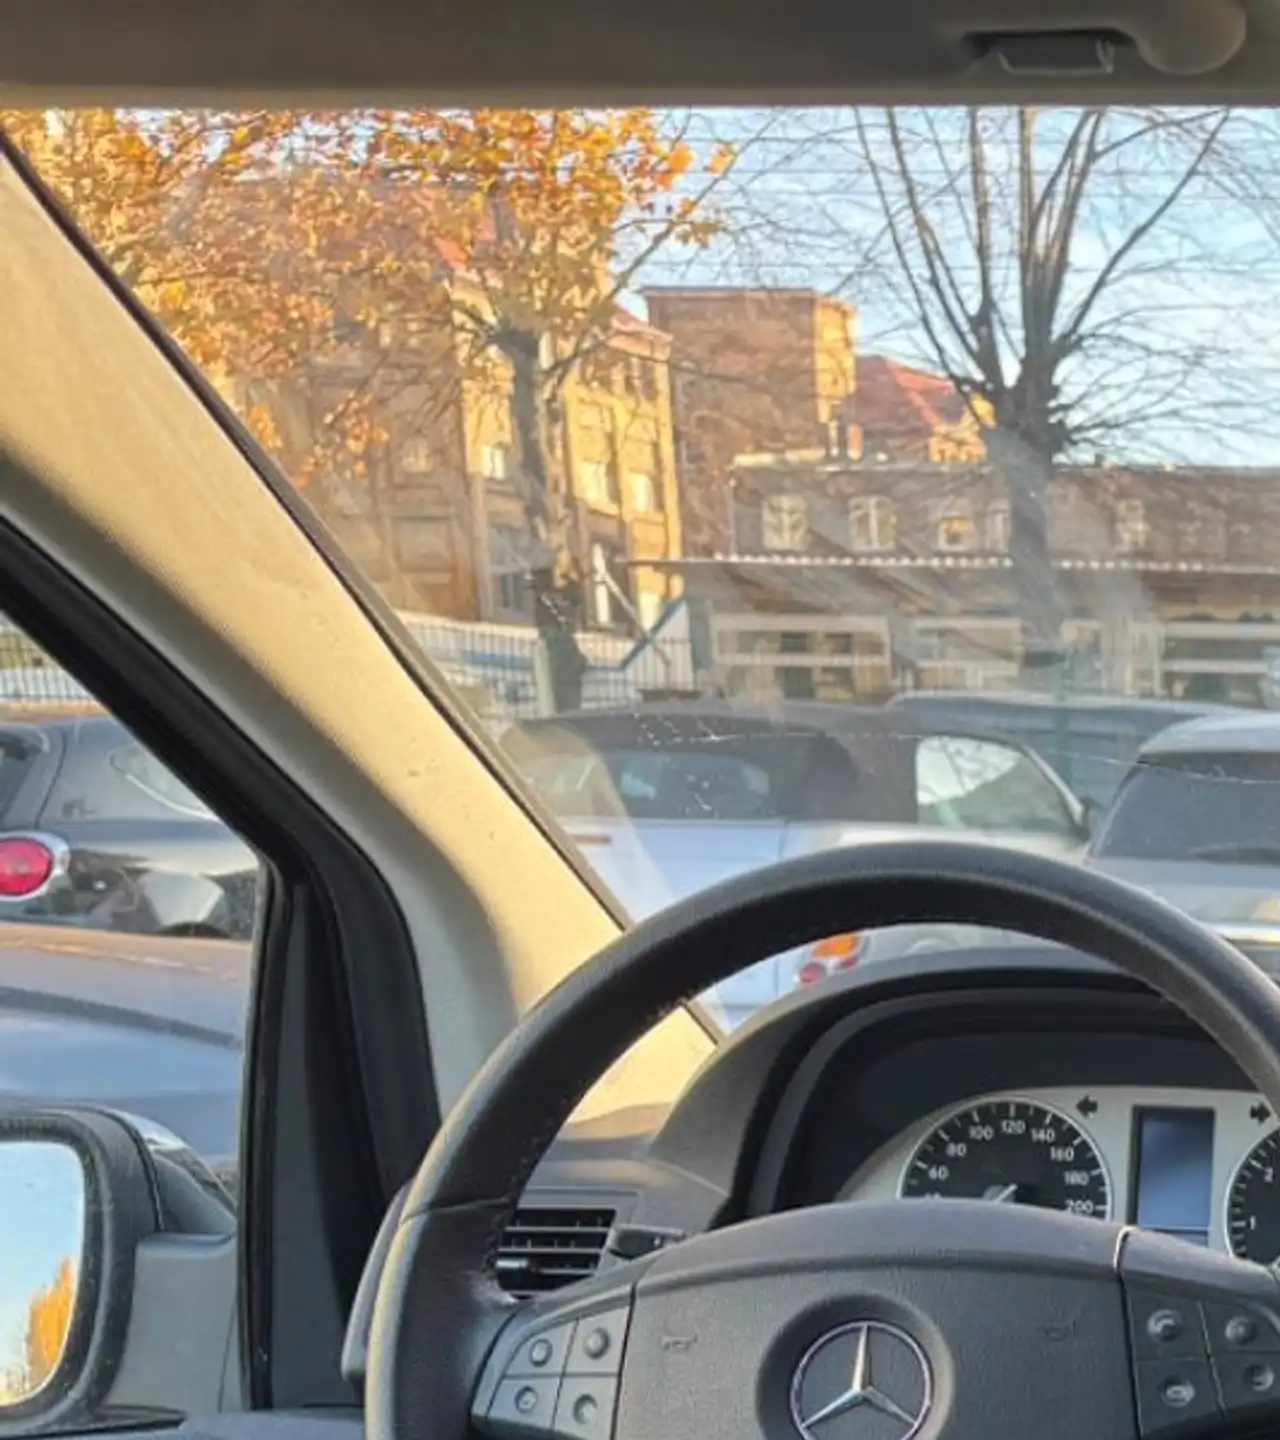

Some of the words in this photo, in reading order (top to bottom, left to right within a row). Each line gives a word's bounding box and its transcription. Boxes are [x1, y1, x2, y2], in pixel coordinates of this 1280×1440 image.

[968, 1126, 995, 1141] 100
[1000, 1119, 1026, 1135] 120
[1031, 1128, 1056, 1143] 140
[946, 1142, 968, 1158] 80
[1050, 1147, 1075, 1162] 160
[928, 1165, 950, 1181] 60
[1063, 1170, 1090, 1186] 180
[1066, 1200, 1094, 1214] 200
